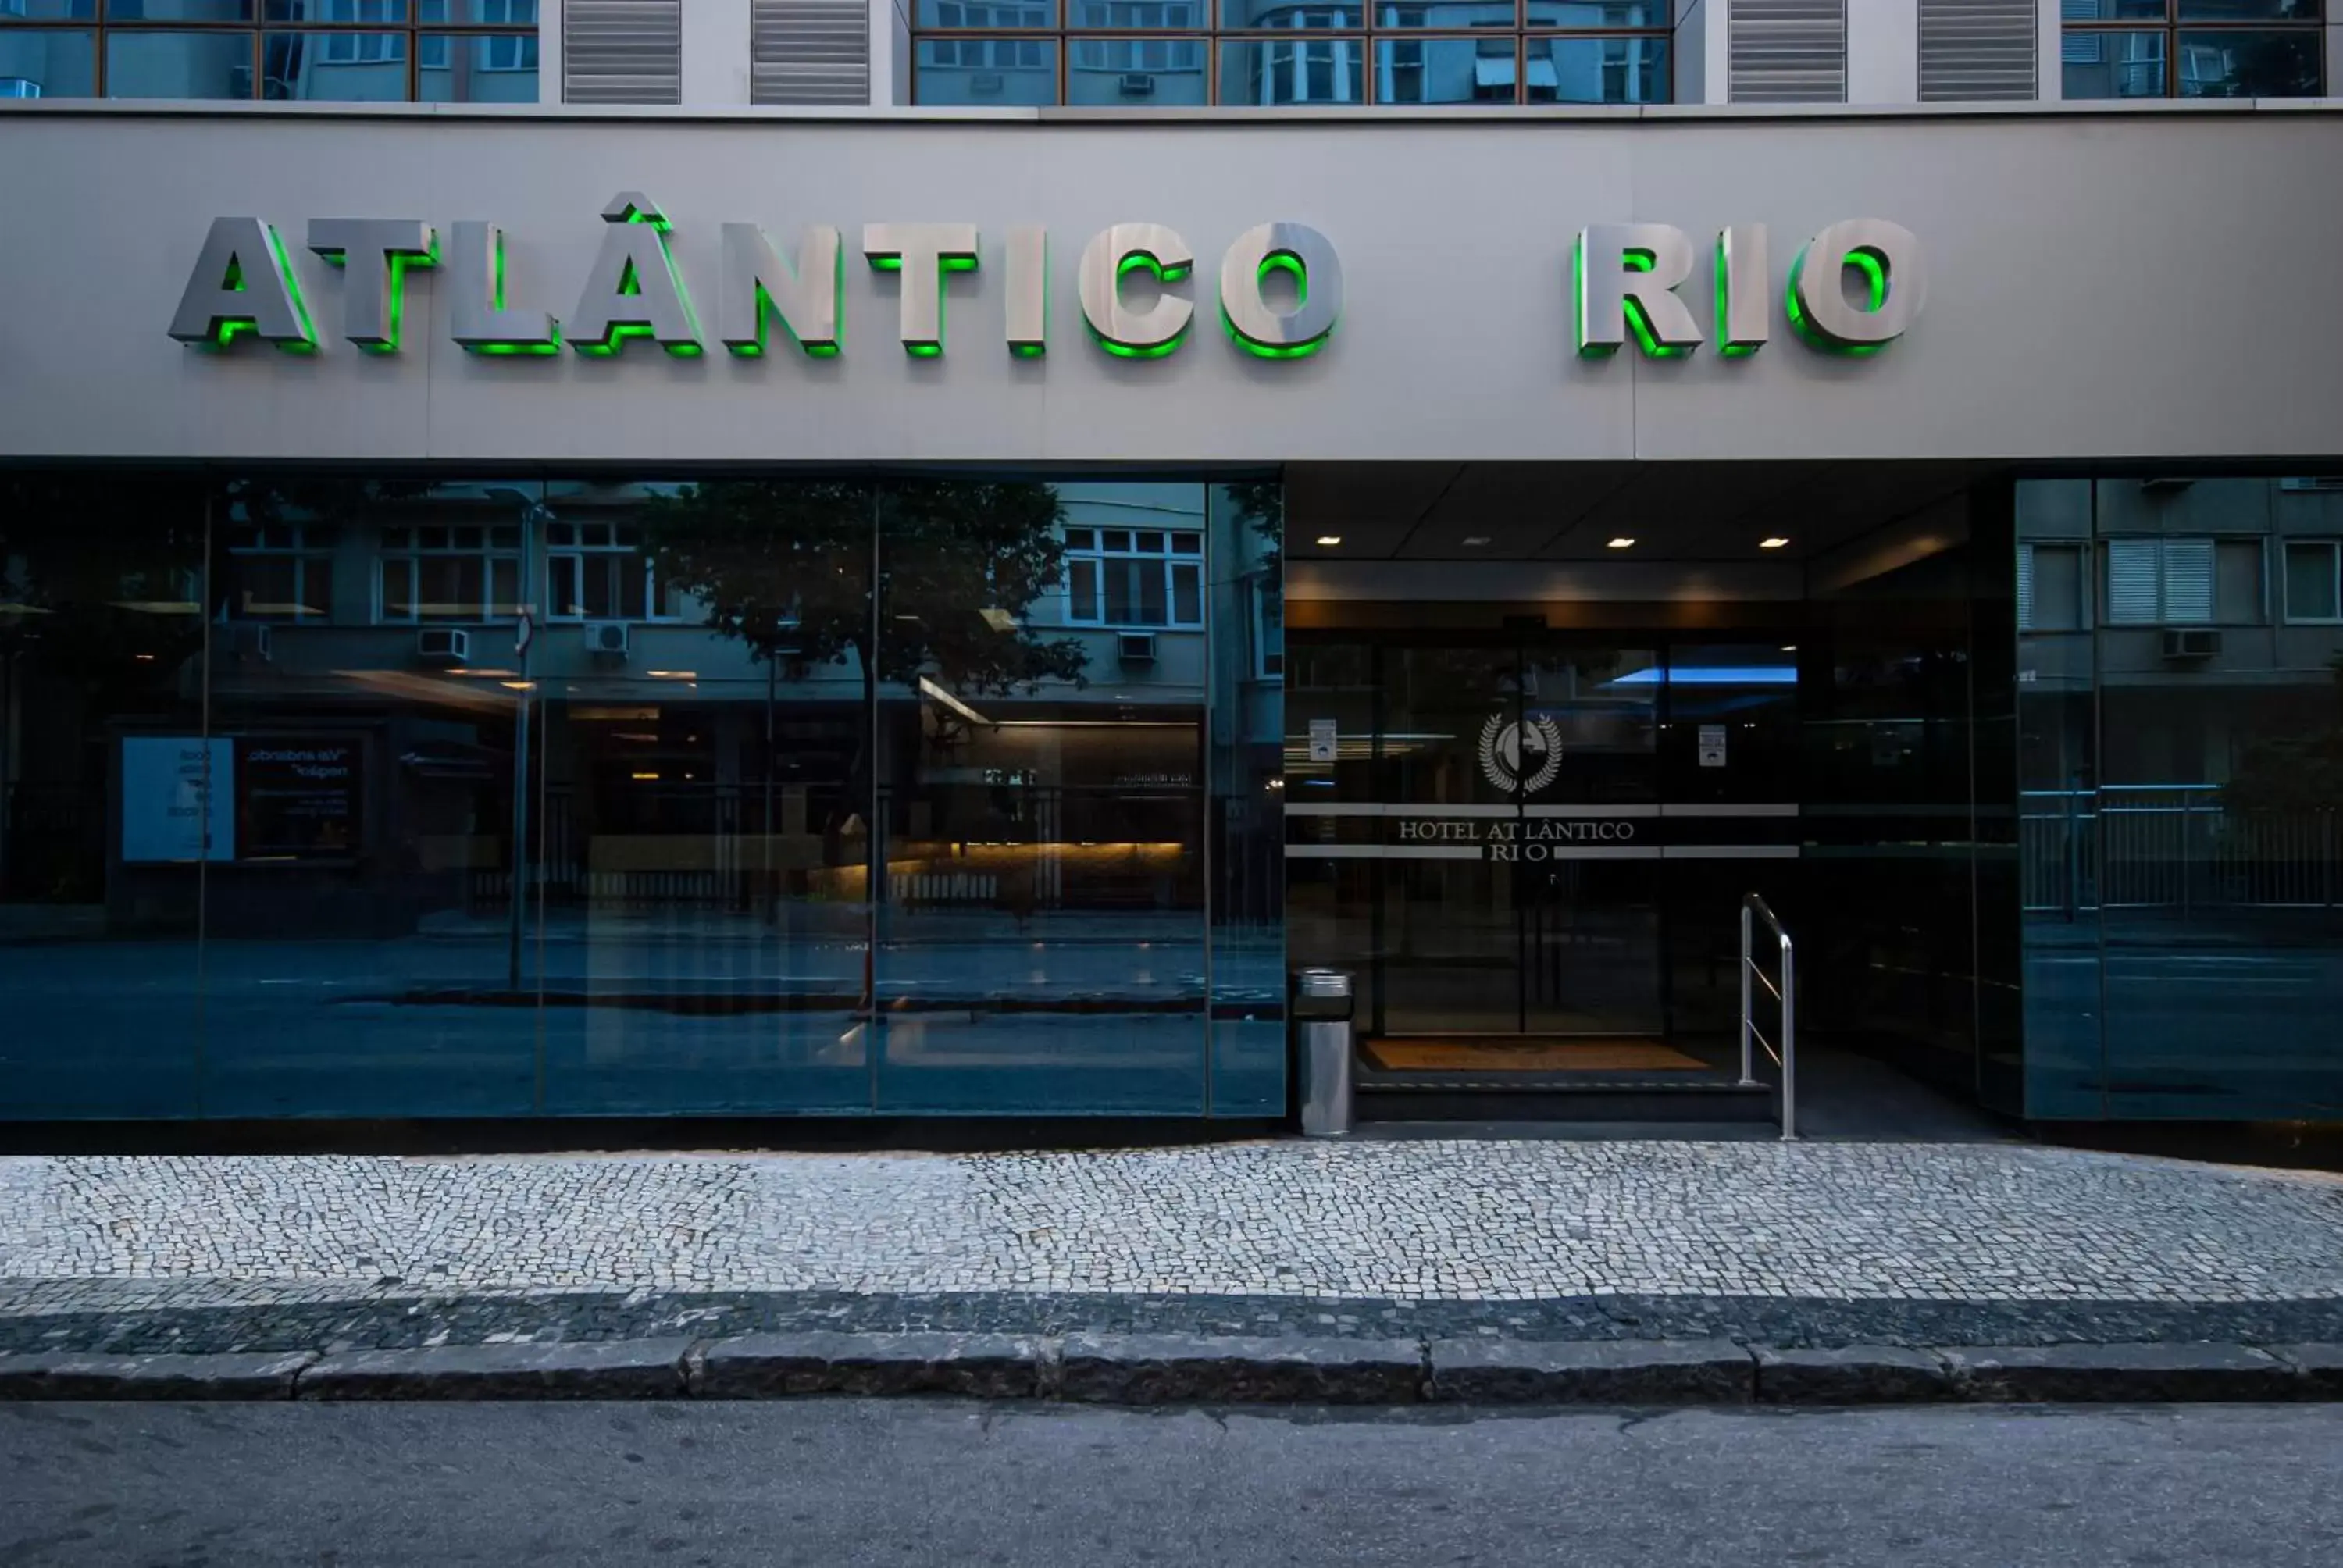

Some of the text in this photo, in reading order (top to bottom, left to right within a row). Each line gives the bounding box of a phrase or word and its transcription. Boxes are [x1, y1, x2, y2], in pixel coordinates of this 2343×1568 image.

[166, 191, 1928, 358] ATLÂNTICO RIO
[1399, 818, 1635, 841] HOTEL ATLÂNTICO
[1489, 844, 1548, 861] RIO
